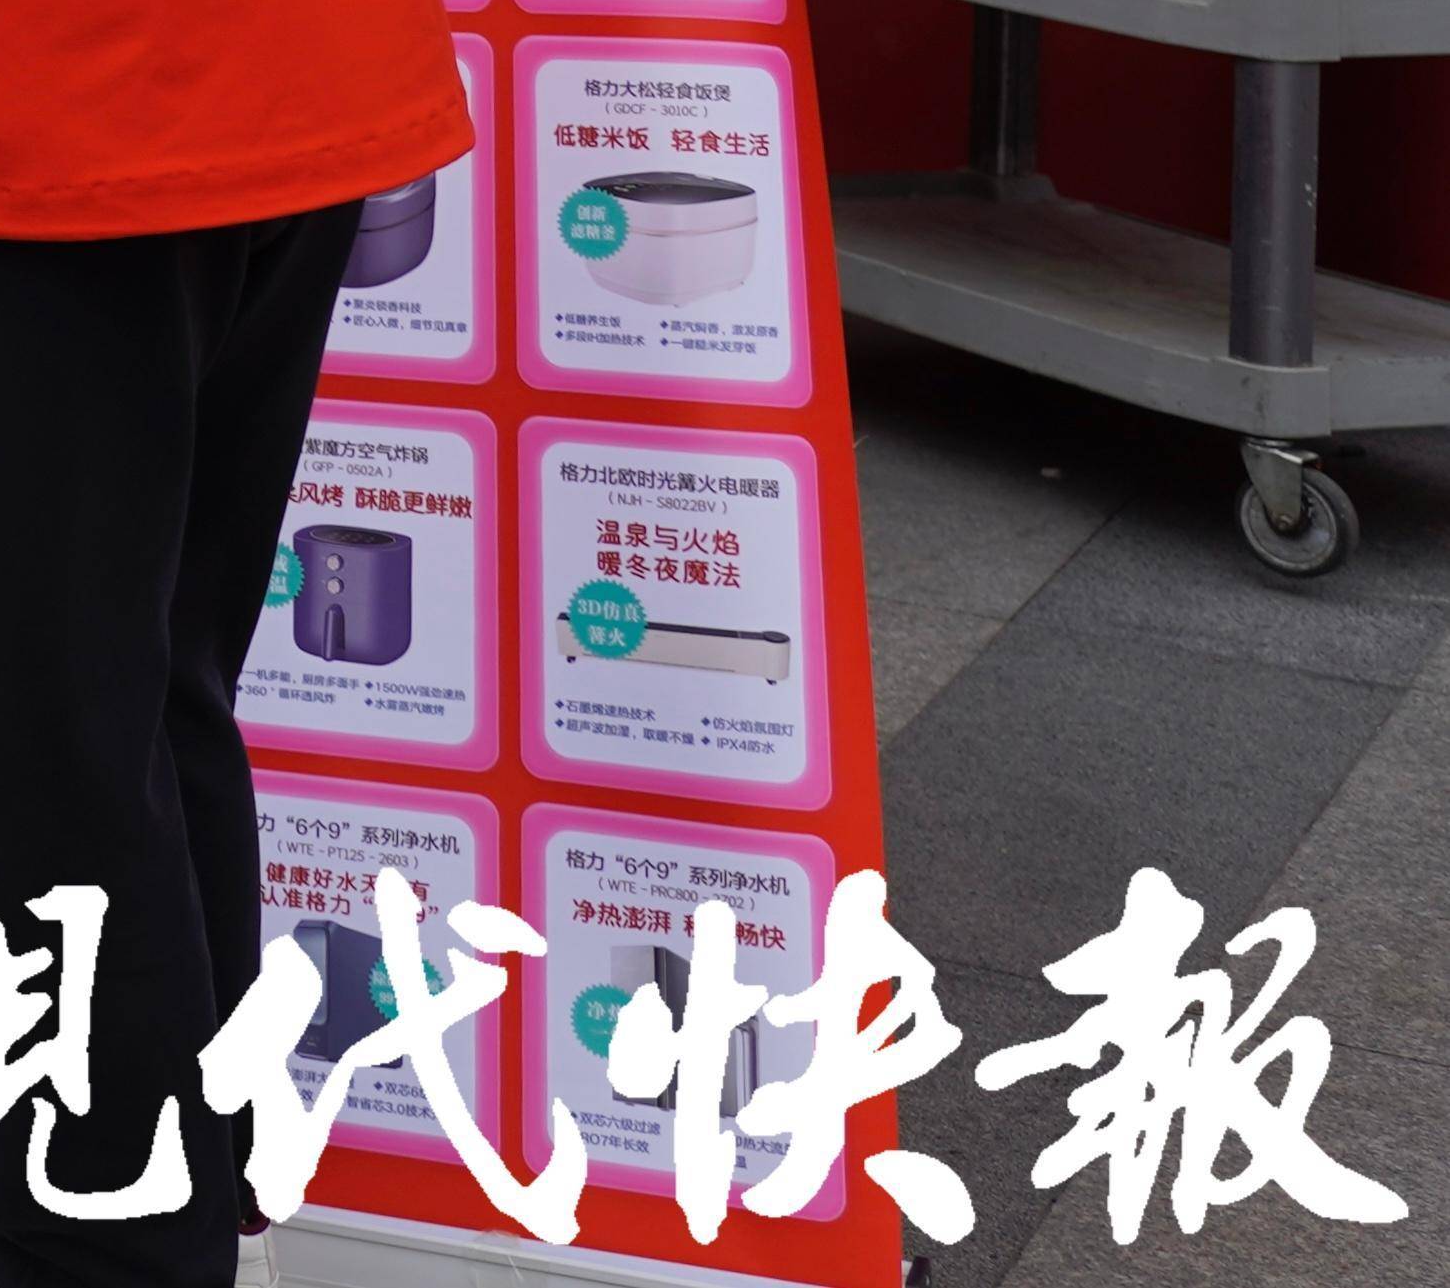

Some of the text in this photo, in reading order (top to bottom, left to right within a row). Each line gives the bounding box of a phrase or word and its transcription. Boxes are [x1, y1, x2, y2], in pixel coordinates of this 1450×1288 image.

[584, 78, 732, 104] 格力大松轻食饭煲
[553, 124, 771, 158] 低糖米饭 轻食生活
[576, 204, 607, 223] 创新
[559, 461, 782, 501] 格力北欧时光篝火电暖器
[354, 485, 473, 521] 酥脆更鲜嫩
[595, 516, 742, 558] 温泉与火焰
[595, 550, 742, 590] 暖冬夜魔法
[576, 597, 647, 625] 3D仿真
[587, 625, 627, 649] 篝火
[572, 898, 788, 952] 净热澎湃 畅快
